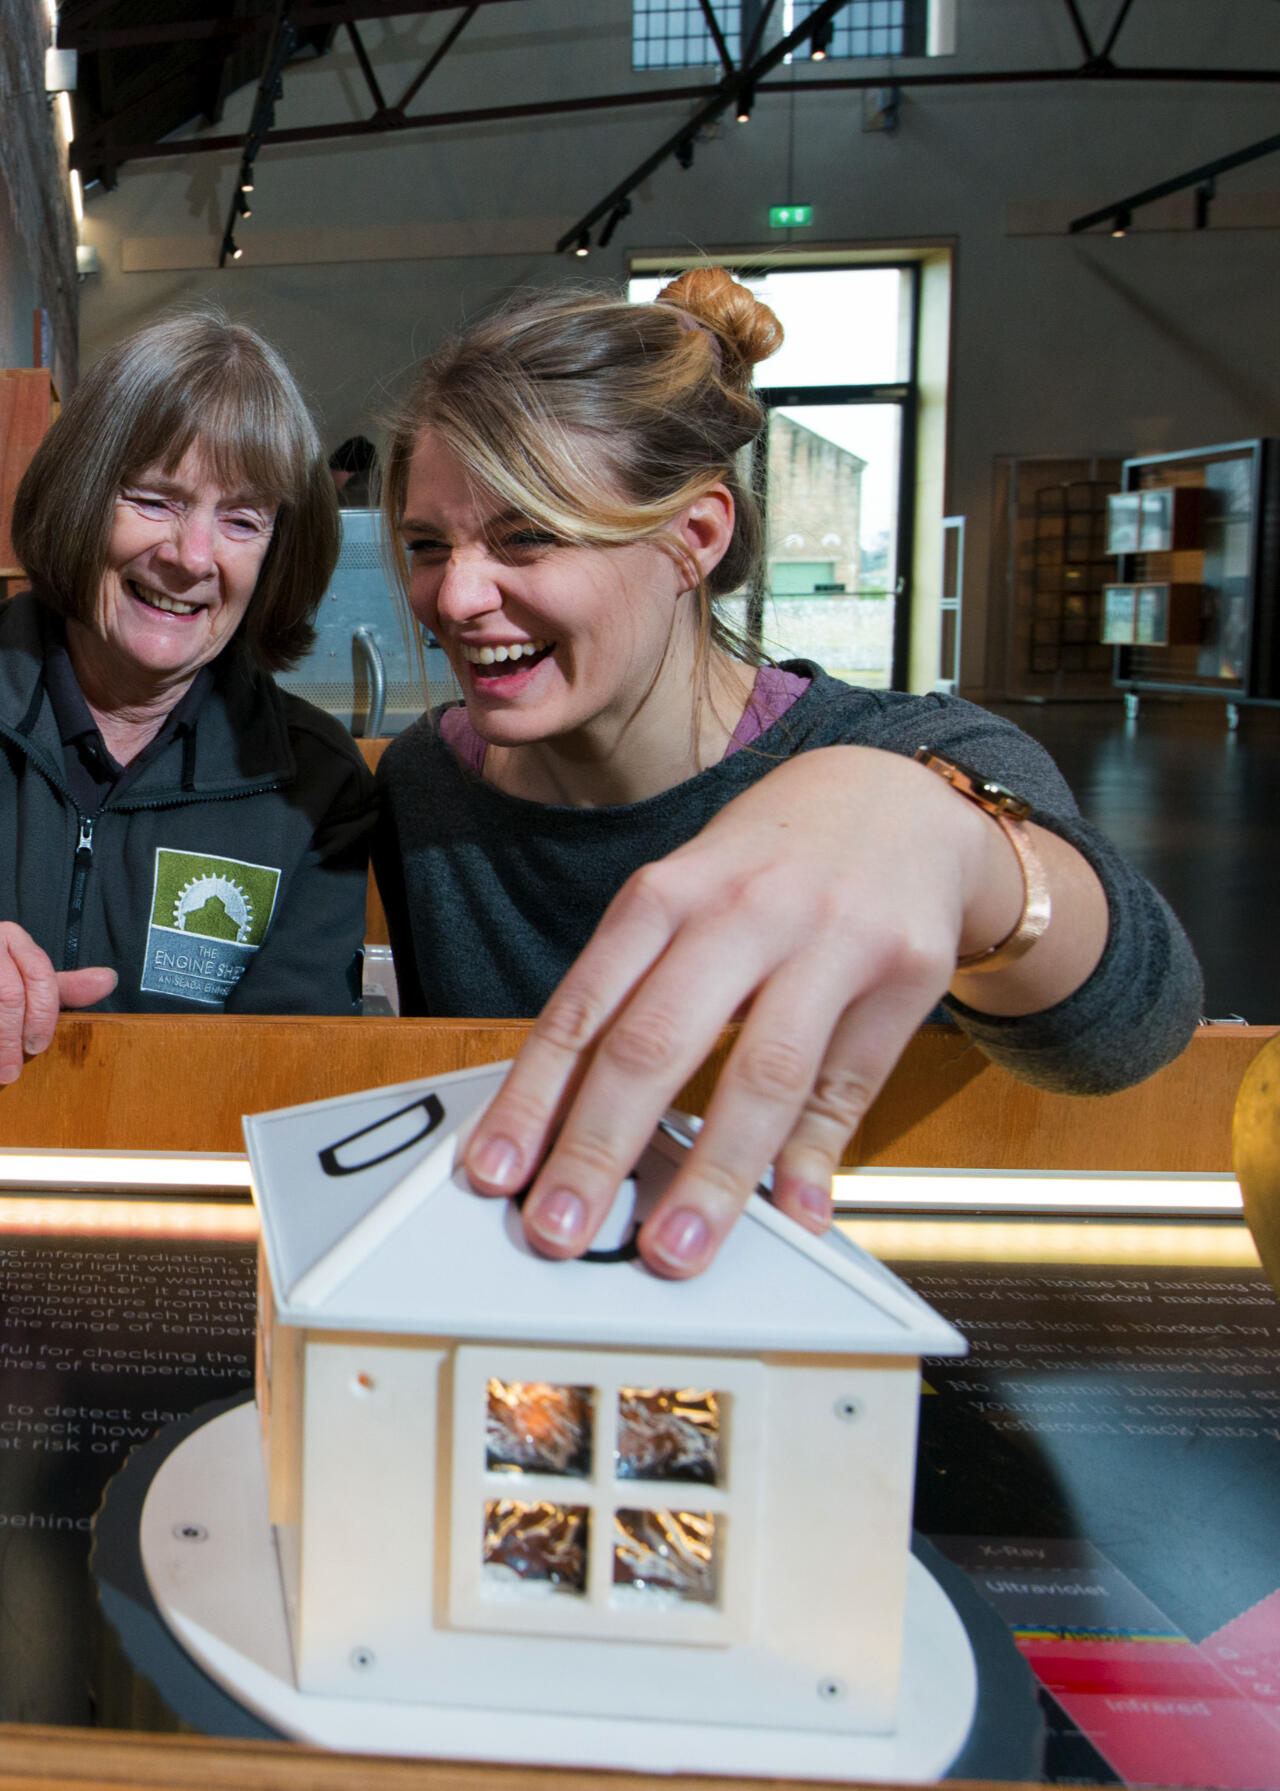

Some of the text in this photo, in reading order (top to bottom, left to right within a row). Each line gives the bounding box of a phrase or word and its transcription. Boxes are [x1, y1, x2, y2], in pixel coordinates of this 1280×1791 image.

[199, 945, 218, 959] THE
[155, 950, 215, 975] ENGINE
[36, 1249, 120, 1260] infrared
[1, 1258, 58, 1269] form
[60, 1260, 83, 1270] of
[90, 1261, 140, 1273] light
[147, 1264, 214, 1275] which
[222, 1266, 239, 1275] is
[116, 1273, 157, 1284] The
[165, 1276, 253, 1287] warmer
[917, 1276, 958, 1285] the
[964, 1277, 1039, 1287] model
[1040, 1278, 1115, 1288] house
[1117, 1280, 1150, 1291] by
[1154, 1281, 1249, 1293] turning
[155, 1286, 169, 1296] it
[177, 1288, 257, 1298] appear
[918, 1289, 1276, 1305] hich of the window materials
[1, 1293, 146, 1308] temperature
[155, 1298, 210, 1309] from
[219, 1300, 257, 1311] the
[7, 1305, 82, 1317] colour
[90, 1308, 115, 1318] of
[122, 1310, 179, 1321] each
[188, 1311, 245, 1323] pixel
[4, 1316, 42, 1328] the
[51, 1319, 120, 1332] range
[128, 1322, 154, 1332] of
[950, 1318, 1036, 1330] frared
[1037, 1320, 1100, 1332] light
[1103, 1323, 1128, 1332] is
[1128, 1322, 1234, 1335] blocked
[1234, 1324, 1270, 1337] by
[39, 1344, 70, 1356] for
[82, 1347, 197, 1363] checking
[205, 1350, 248, 1364] the
[968, 1340, 1009, 1352] We
[1086, 1345, 1133, 1355] see
[1135, 1345, 1247, 1359] through
[55, 1359, 83, 1372] of
[91, 1361, 252, 1379] temperature
[1038, 1359, 1089, 1371] but
[1094, 1361, 1202, 1373] infrared
[1202, 1362, 1271, 1376] light
[999, 1381, 1123, 1396] Thermal
[1124, 1386, 1246, 1399] blankets
[7, 1403, 35, 1417] to
[44, 1405, 136, 1421] detect
[968, 1401, 1085, 1414] yourself
[1147, 1404, 1263, 1417] thermal
[0, 1418, 81, 1435] check
[91, 1422, 149, 1437] how
[988, 1420, 1120, 1433] reflected
[1120, 1422, 1195, 1435] back
[1195, 1424, 1258, 1437] into
[32, 1437, 80, 1452] risk
[91, 1439, 124, 1453] of
[986, 1581, 1111, 1596] Ultraviolet
[1104, 1699, 1212, 1717] Infrared
